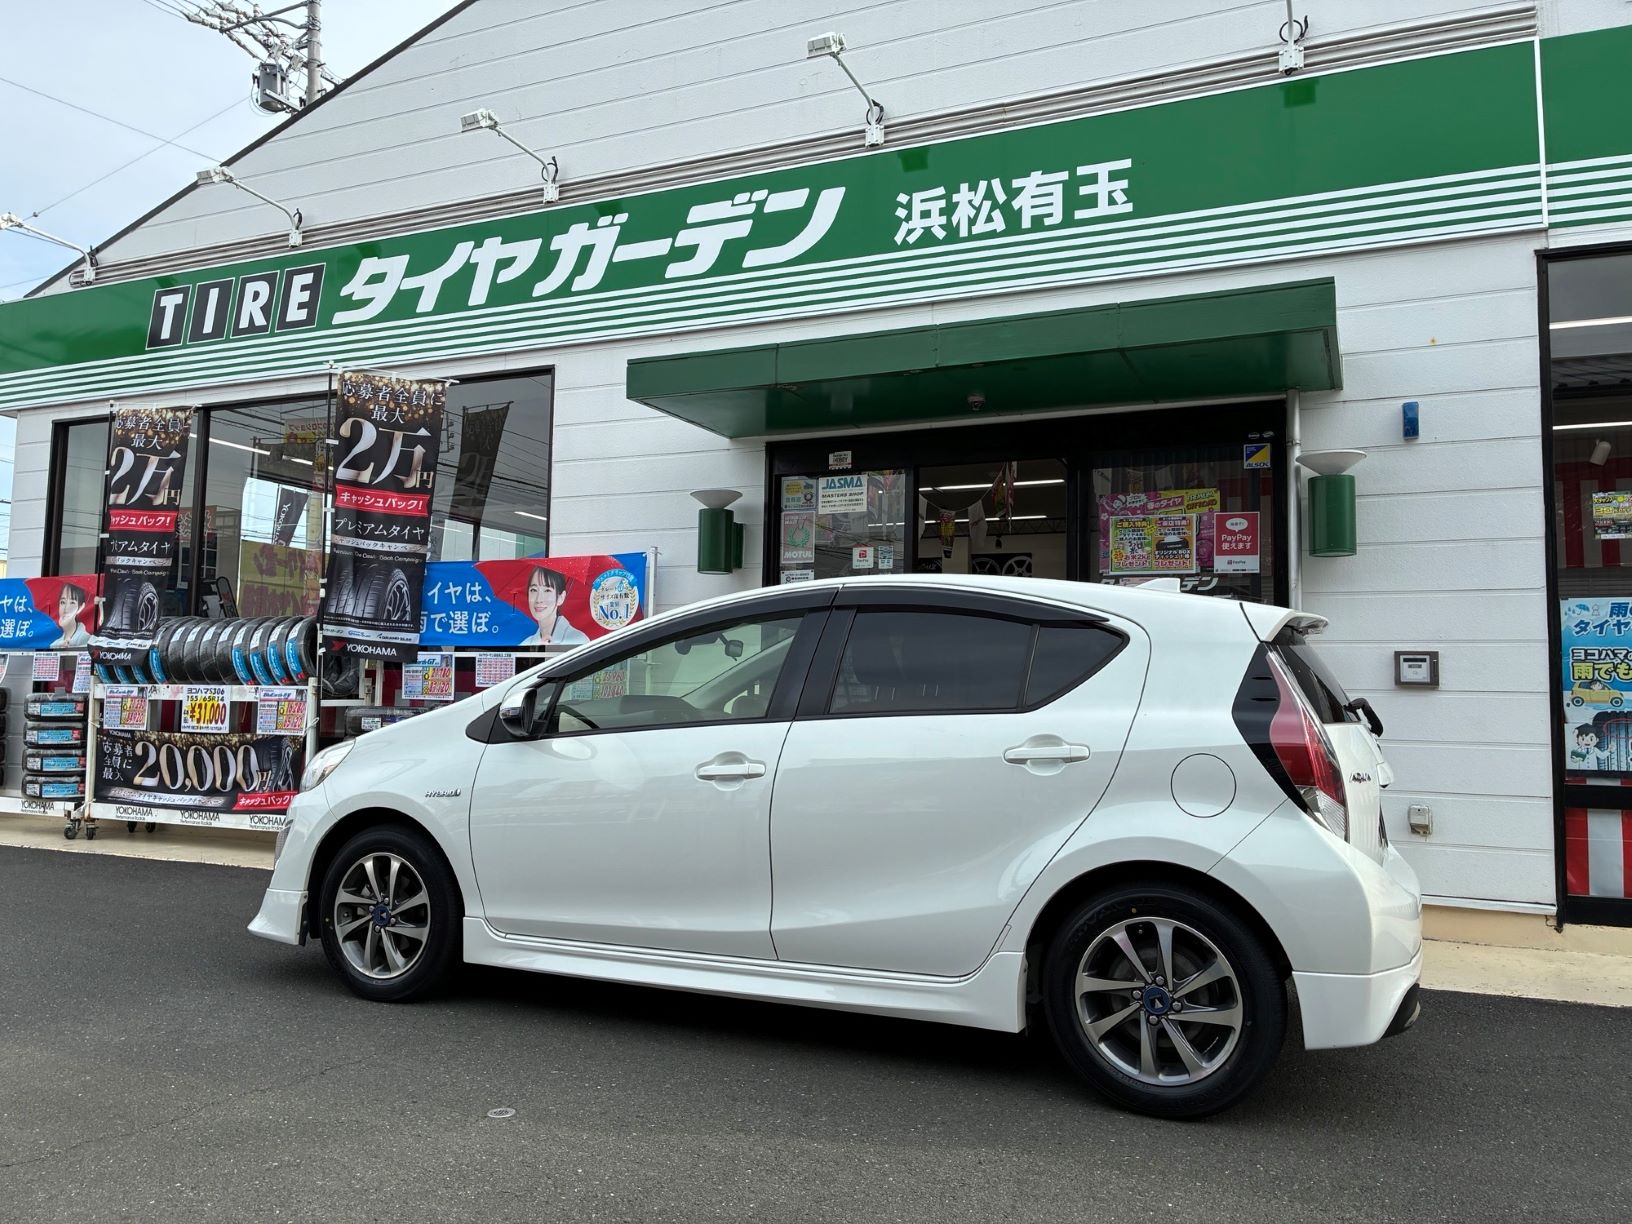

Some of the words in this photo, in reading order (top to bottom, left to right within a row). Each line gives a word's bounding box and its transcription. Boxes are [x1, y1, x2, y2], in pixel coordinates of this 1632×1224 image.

[160, 272, 314, 340] TIRE
[332, 186, 846, 325] タイヤガーデン
[894, 158, 1133, 246] 浜松有玉
[342, 380, 443, 407] 応募者全員に
[371, 404, 405, 424] 最大
[131, 433, 162, 450] 最大
[336, 417, 434, 489] 2万円
[109, 446, 181, 505] 2万円
[822, 477, 863, 490] JASMA
[340, 490, 424, 511] キャッシュバック!
[335, 517, 425, 541] プレミアムタイヤ
[1221, 534, 1251, 543] PayPay
[1221, 542, 1251, 550] 使えます
[783, 550, 813, 559] MOTUL
[598, 603, 629, 620] No.1
[1574, 619, 1631, 635] タイヤ
[346, 643, 397, 656] YOKOHAMA
[190, 702, 227, 725] ¥31,000
[109, 729, 132, 738] YOKOHAMA
[132, 741, 272, 792] 20,000円
[21, 801, 55, 811] YOKOHAMA
[115, 806, 153, 817] YOKOHAMA
[180, 810, 220, 822] YOKOHAMA
